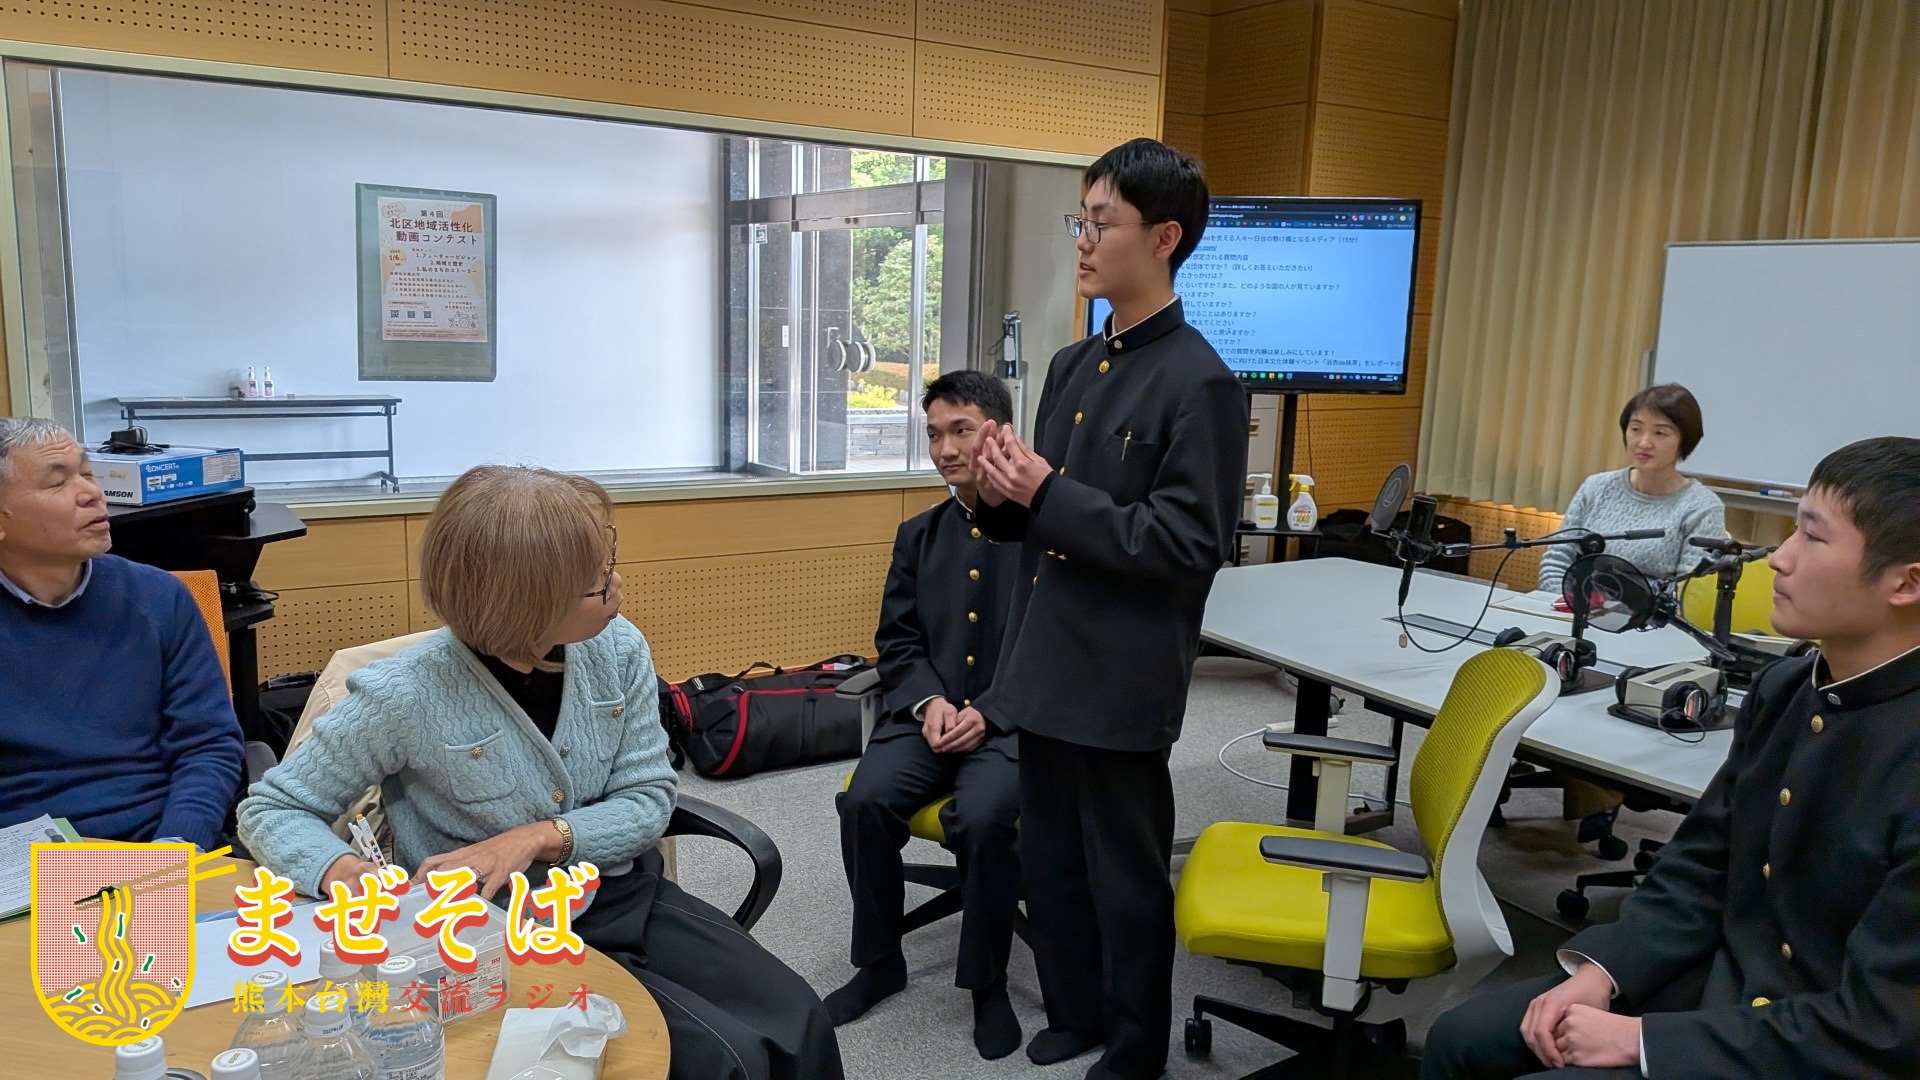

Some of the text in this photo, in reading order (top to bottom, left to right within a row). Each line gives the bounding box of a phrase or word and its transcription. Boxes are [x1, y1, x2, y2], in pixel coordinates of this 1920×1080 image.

[420, 209, 444, 219] 第4回
[389, 217, 473, 233] 北区地域活性化
[396, 230, 478, 246] 動画コンテスト
[104, 489, 134, 498] AMSON
